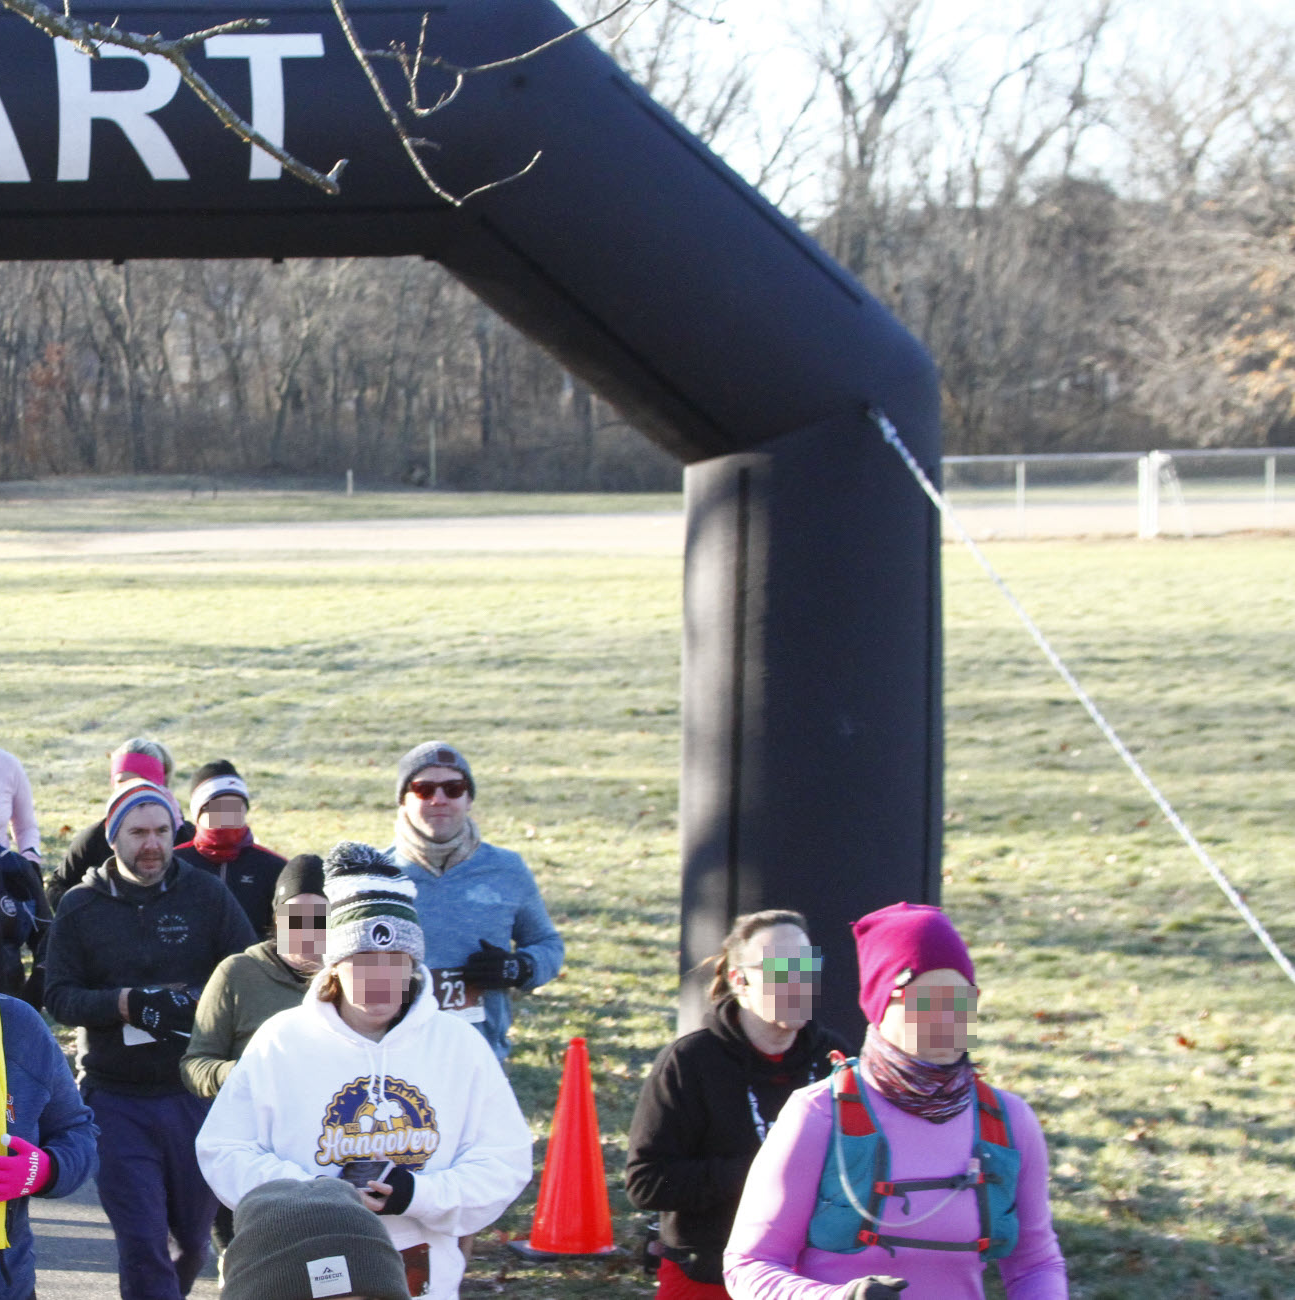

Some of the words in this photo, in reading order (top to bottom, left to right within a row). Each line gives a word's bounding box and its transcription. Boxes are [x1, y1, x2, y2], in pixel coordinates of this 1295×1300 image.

[440, 980, 466, 1008] 23
[316, 1126, 439, 1165] Hangover
[24, 1151, 39, 1186] Mobile
[314, 1272, 343, 1282] RIDGECUT
